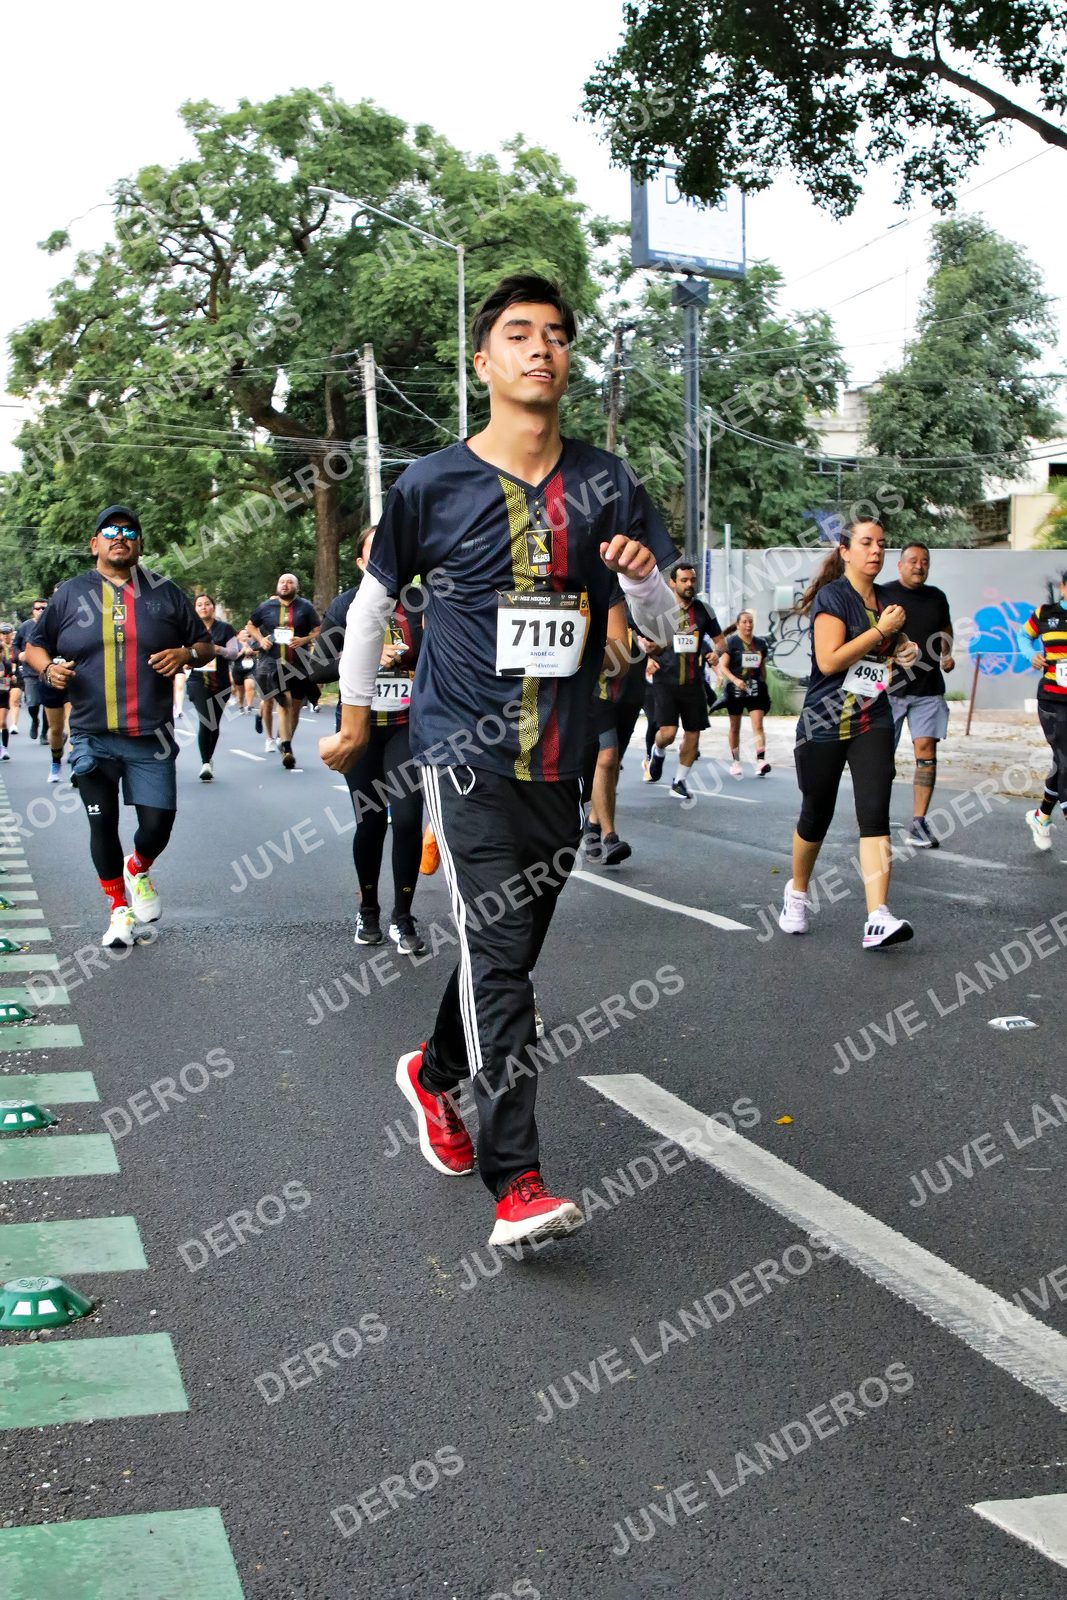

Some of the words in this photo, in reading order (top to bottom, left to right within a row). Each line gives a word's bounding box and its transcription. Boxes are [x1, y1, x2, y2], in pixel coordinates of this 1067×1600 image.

[511, 619, 575, 647] 7118
[854, 665, 884, 683] 4983
[377, 684, 408, 697] 4712
